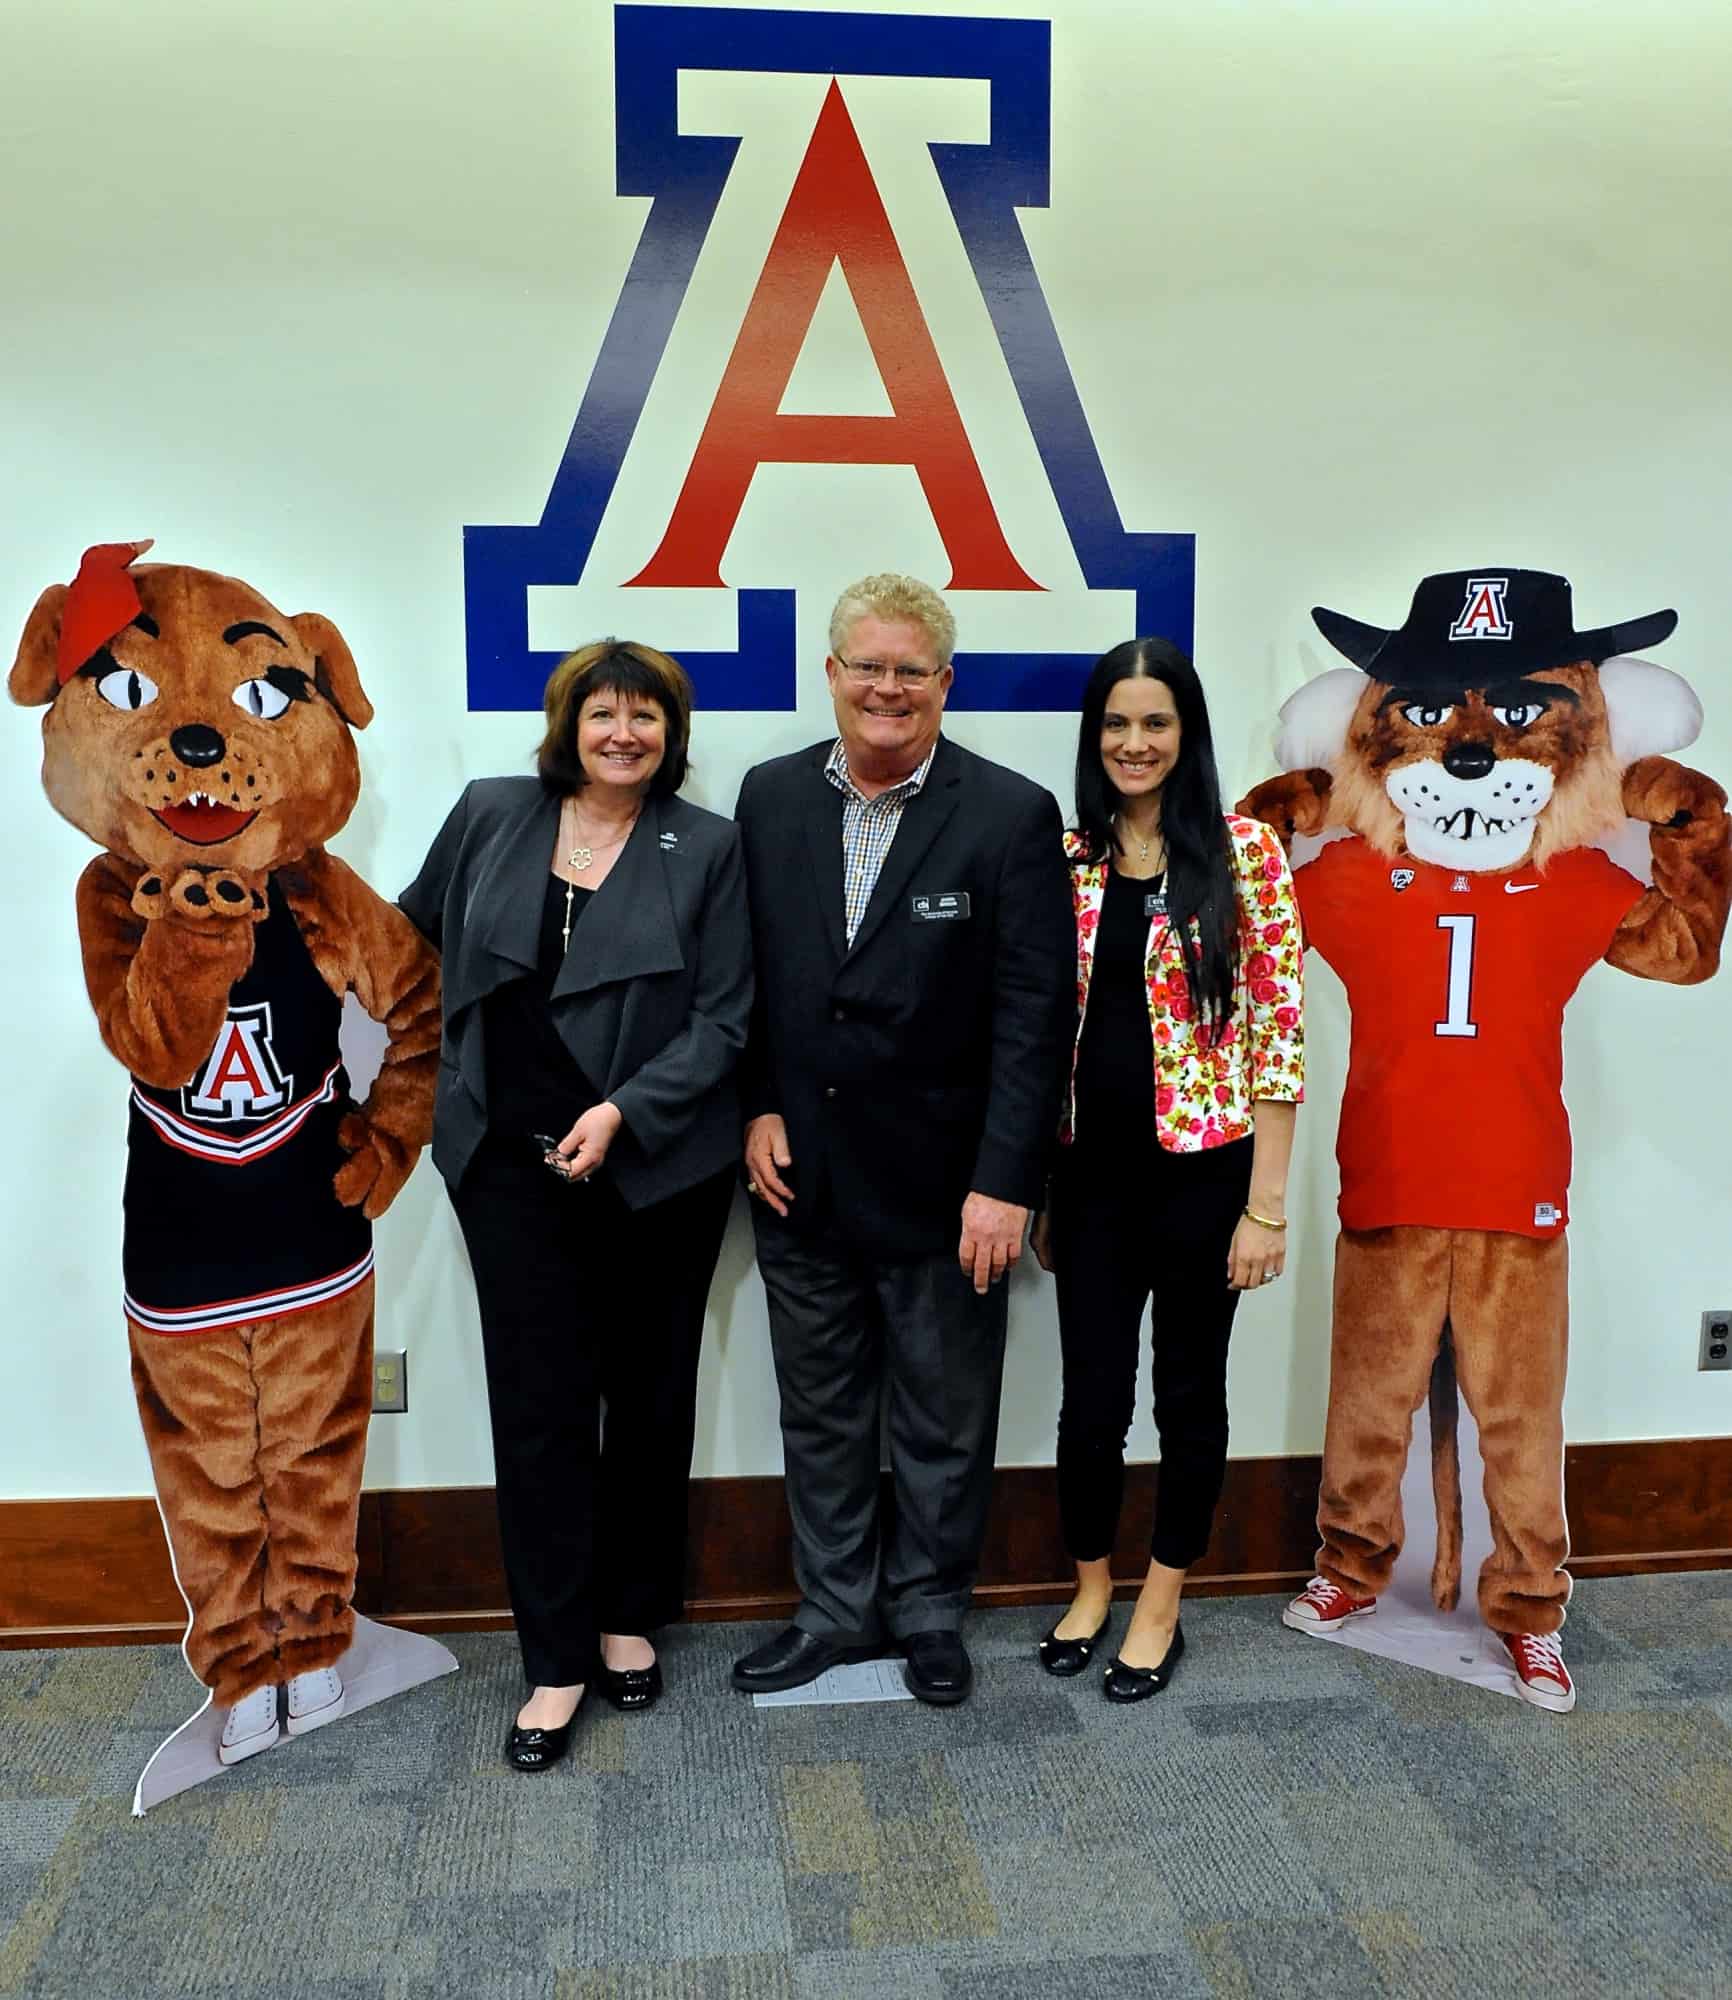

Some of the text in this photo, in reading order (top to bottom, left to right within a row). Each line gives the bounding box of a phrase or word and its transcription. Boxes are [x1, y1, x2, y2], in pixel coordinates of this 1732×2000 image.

[463, 4, 1196, 712] A
[1449, 578, 1513, 640] A
[1435, 914, 1478, 1037] 1
[181, 1001, 293, 1122] A
